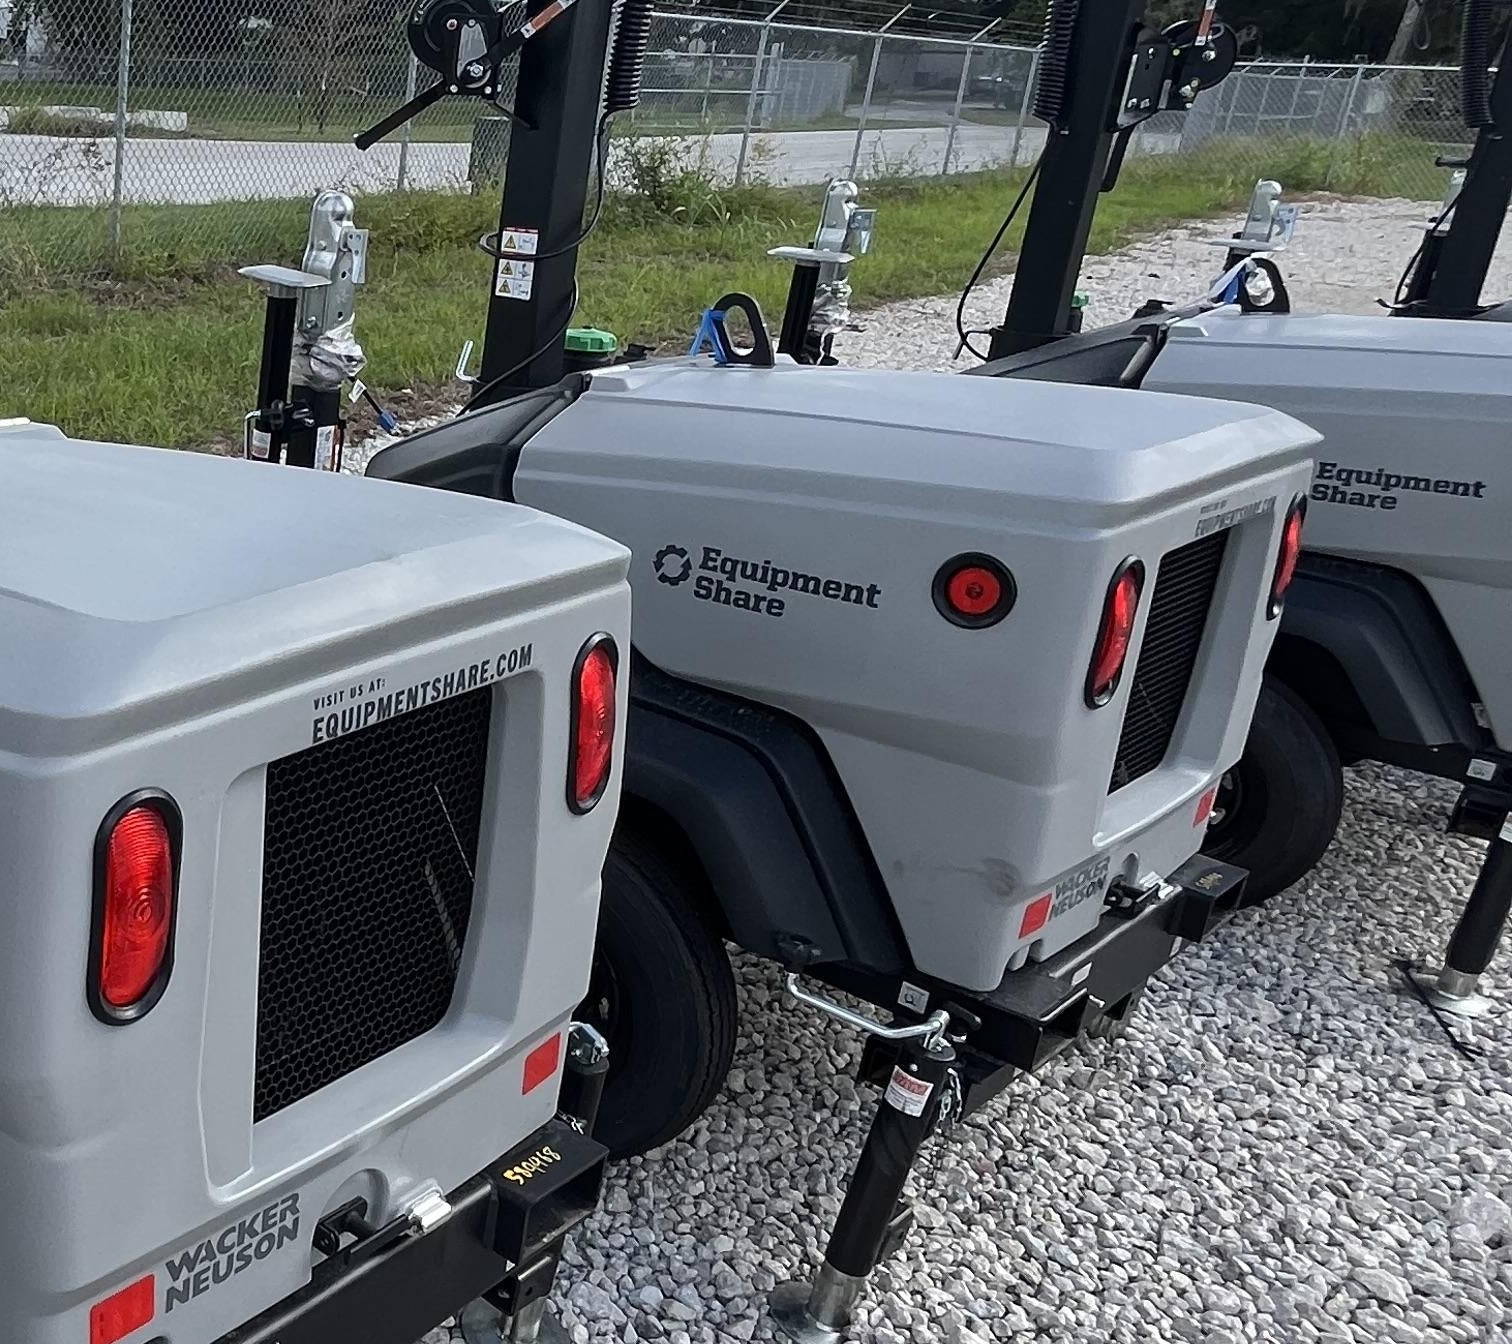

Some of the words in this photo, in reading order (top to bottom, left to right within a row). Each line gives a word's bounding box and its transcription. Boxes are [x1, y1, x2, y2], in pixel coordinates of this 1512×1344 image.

[1310, 483, 1397, 510] Share
[1315, 462, 1487, 498] Equipment
[693, 575, 785, 617] Share
[699, 546, 882, 608] Equipment
[312, 643, 534, 744] EQUIPMENTSHARE.COM
[313, 690, 345, 710] VISIT
[350, 686, 364, 699] US
[369, 678, 386, 693] AT:
[165, 1192, 300, 1282] WACKER
[165, 1216, 300, 1313] NEUSON
